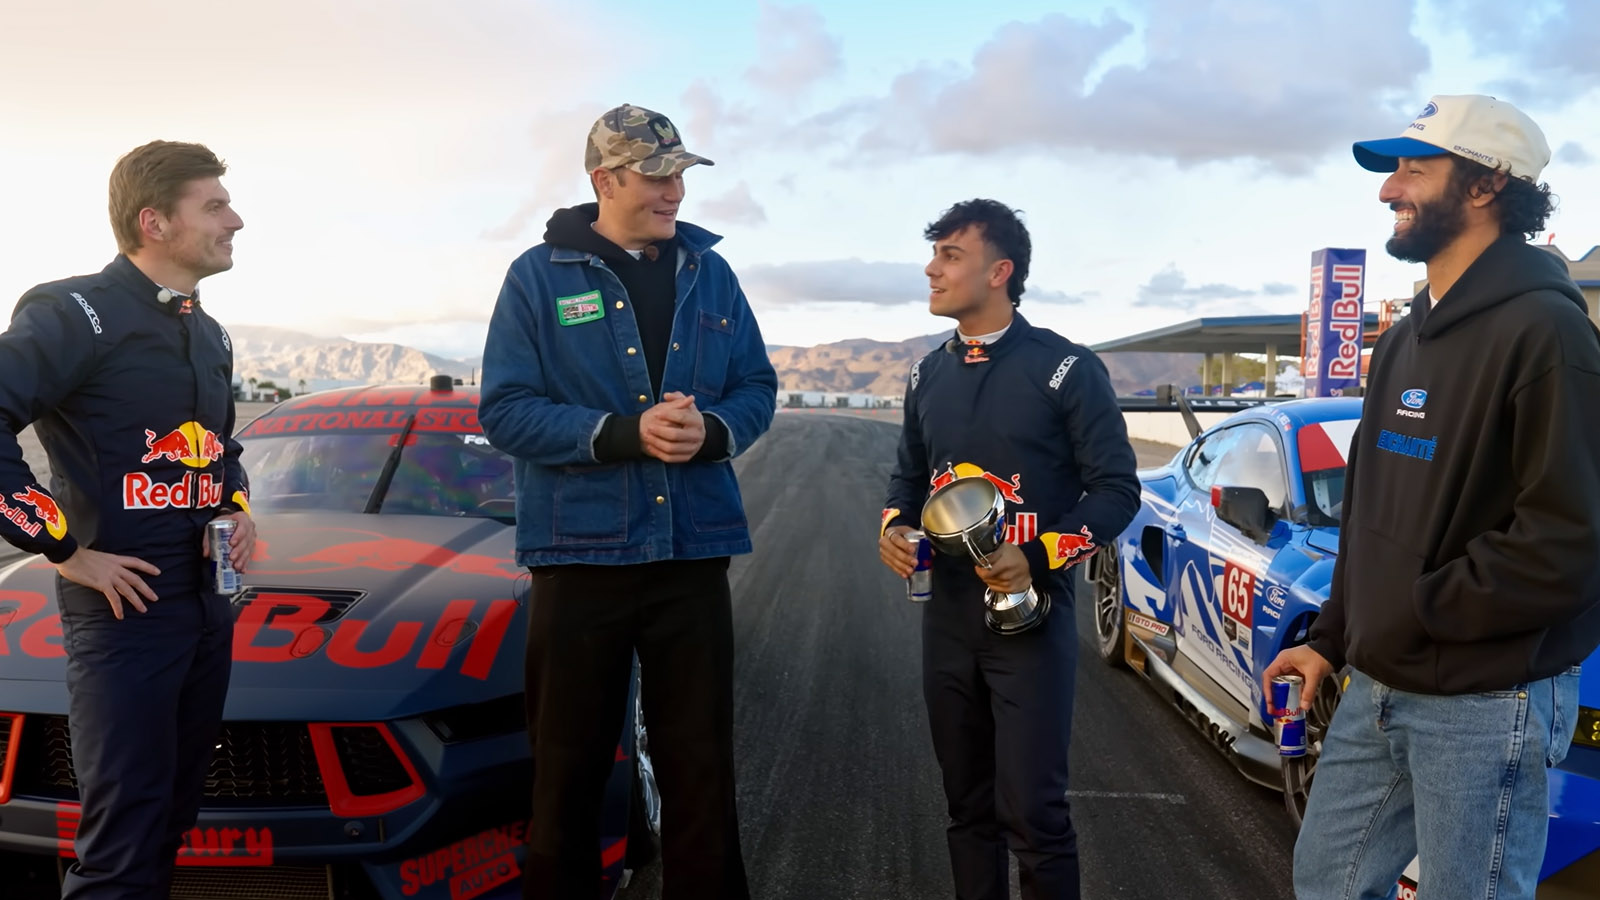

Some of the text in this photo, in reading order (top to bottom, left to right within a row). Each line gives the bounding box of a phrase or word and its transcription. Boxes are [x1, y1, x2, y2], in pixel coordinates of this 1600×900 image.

[1331, 264, 1363, 320] Bull
[70, 292, 102, 334] sparco
[1328, 322, 1361, 379] Red
[123, 470, 224, 509] Red Bu
[12, 511, 43, 538] Bull
[1227, 567, 1249, 619] 65
[229, 593, 518, 681] Bull
[1150, 622, 1167, 634] PRO
[1192, 624, 1215, 653] FORD
[459, 862, 511, 896] AUTO
